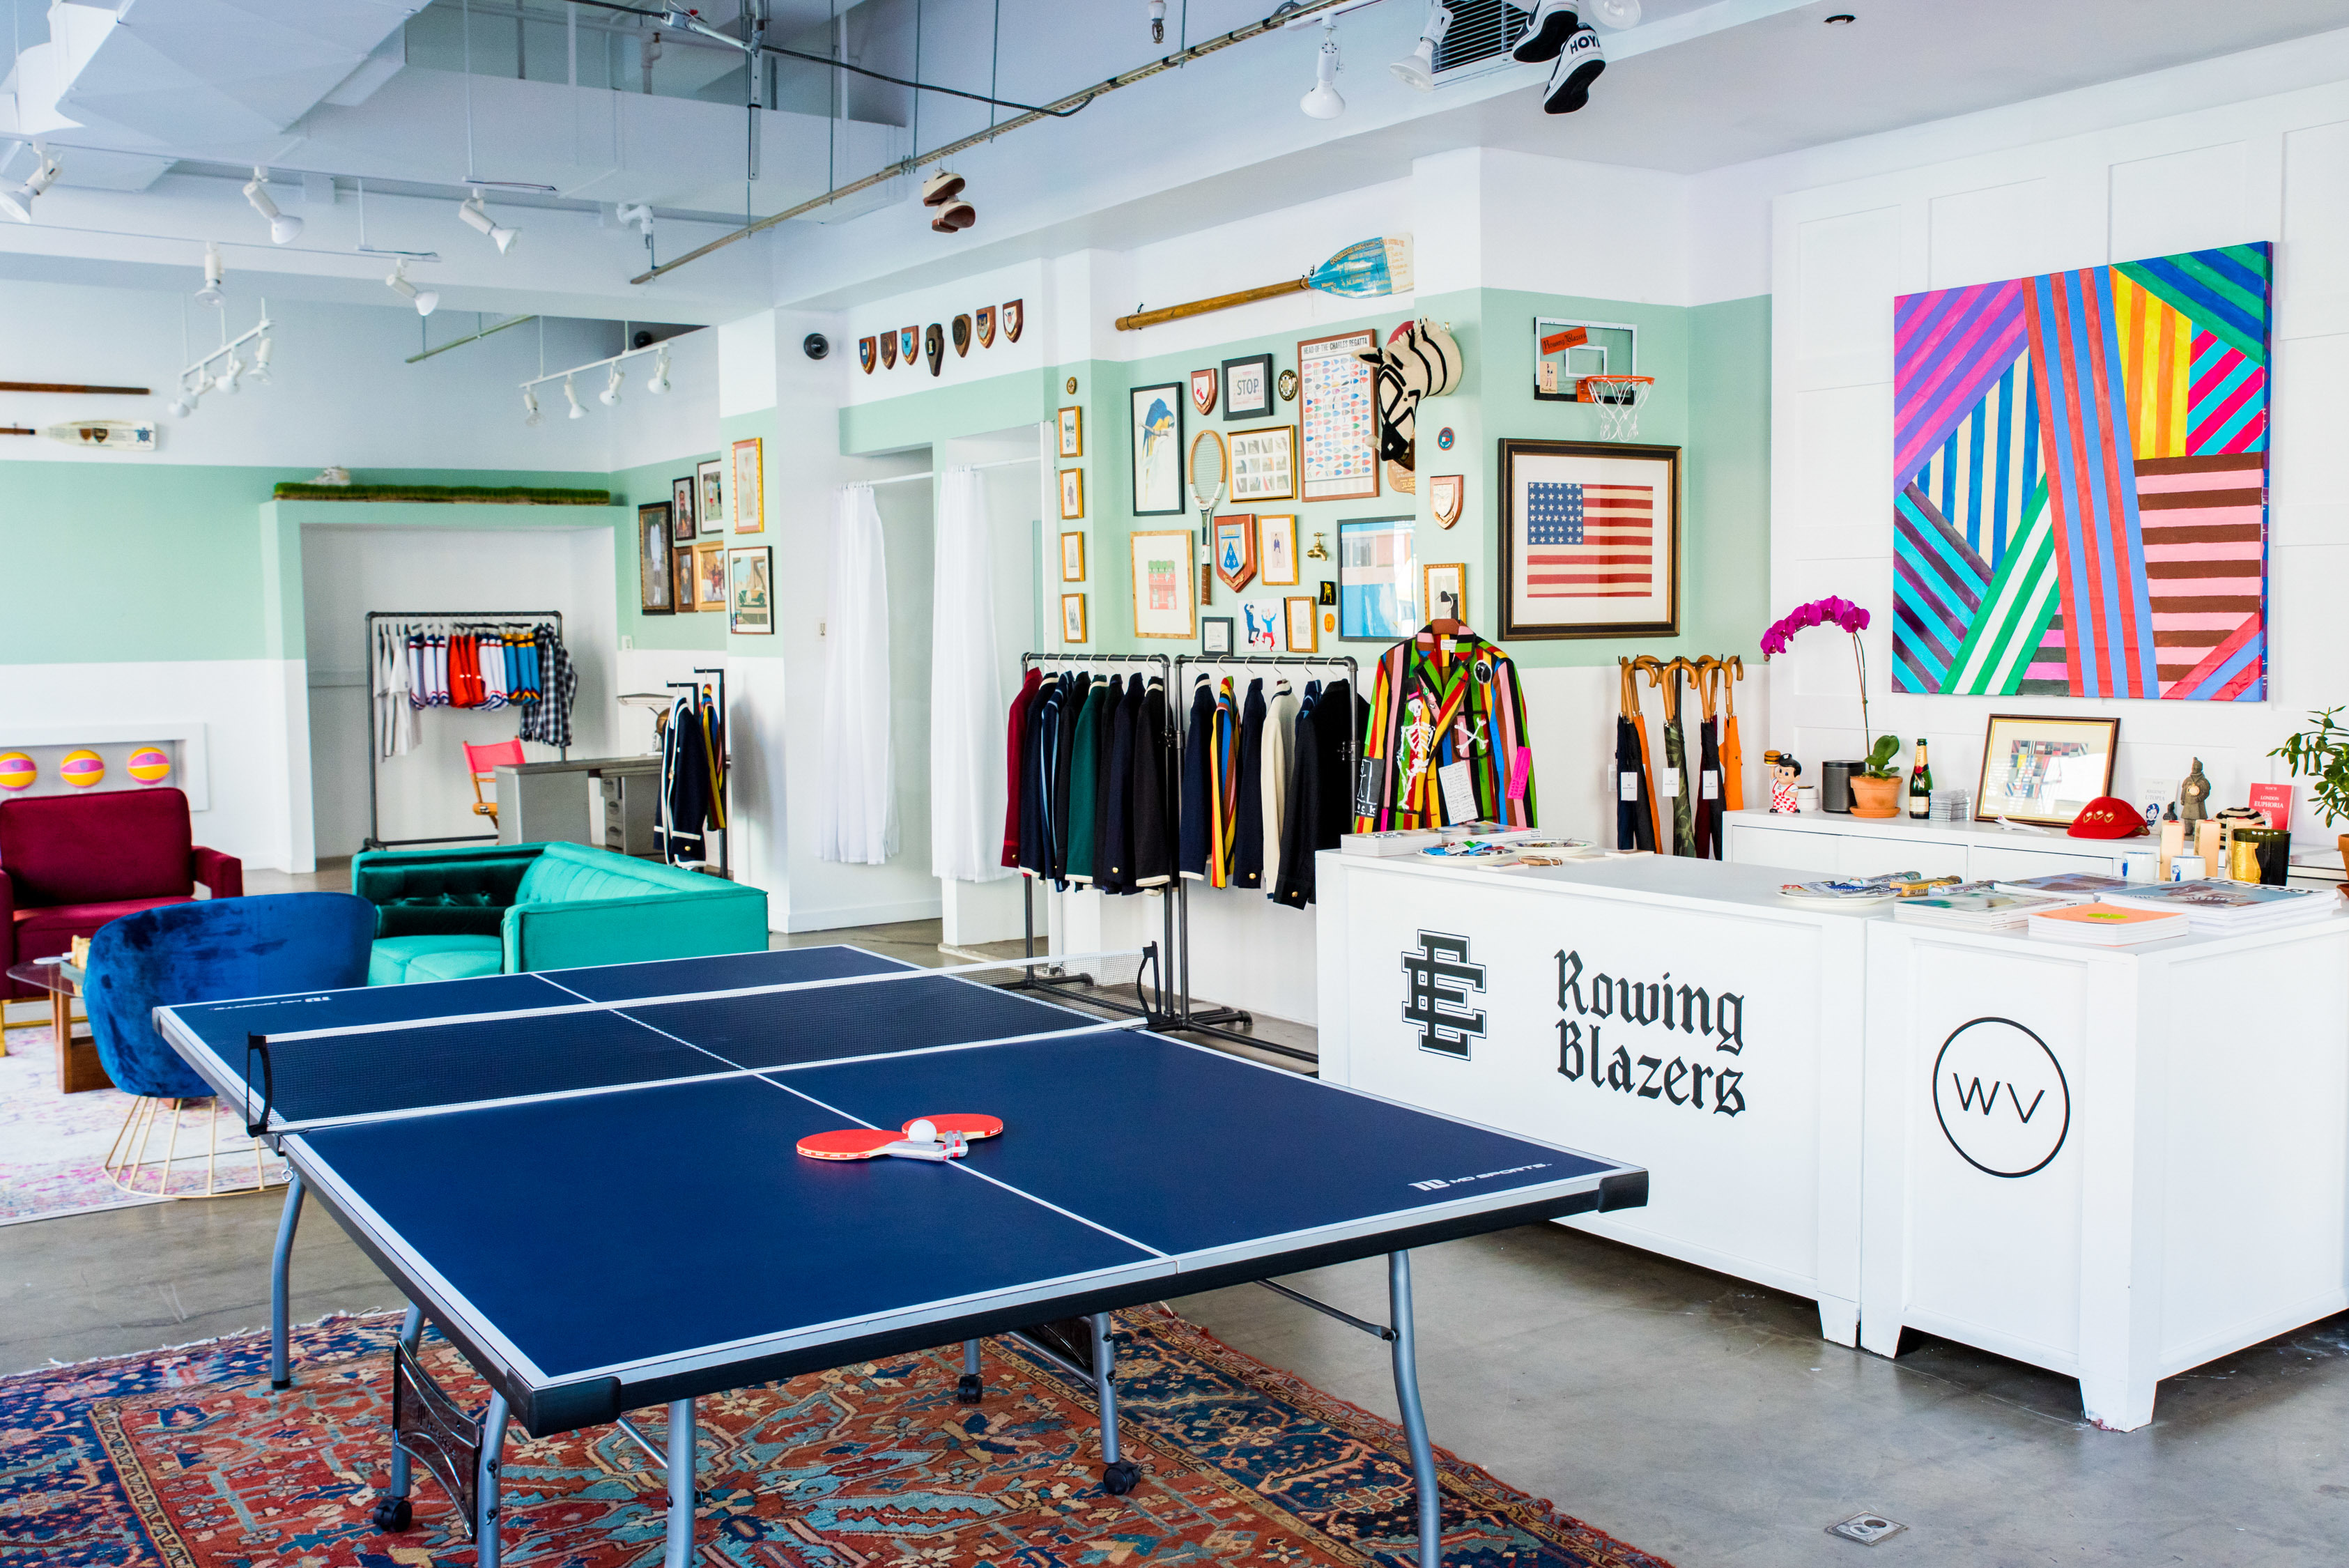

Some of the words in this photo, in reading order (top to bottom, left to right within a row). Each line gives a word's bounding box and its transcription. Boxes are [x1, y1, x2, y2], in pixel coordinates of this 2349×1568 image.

[1330, 339, 1348, 351] CHARLES
[1349, 337, 1368, 347] REGATTA
[1237, 378, 1259, 396] STOP
[1553, 948, 1745, 1056] Rowing
[1555, 1018, 1746, 1118] Blazers
